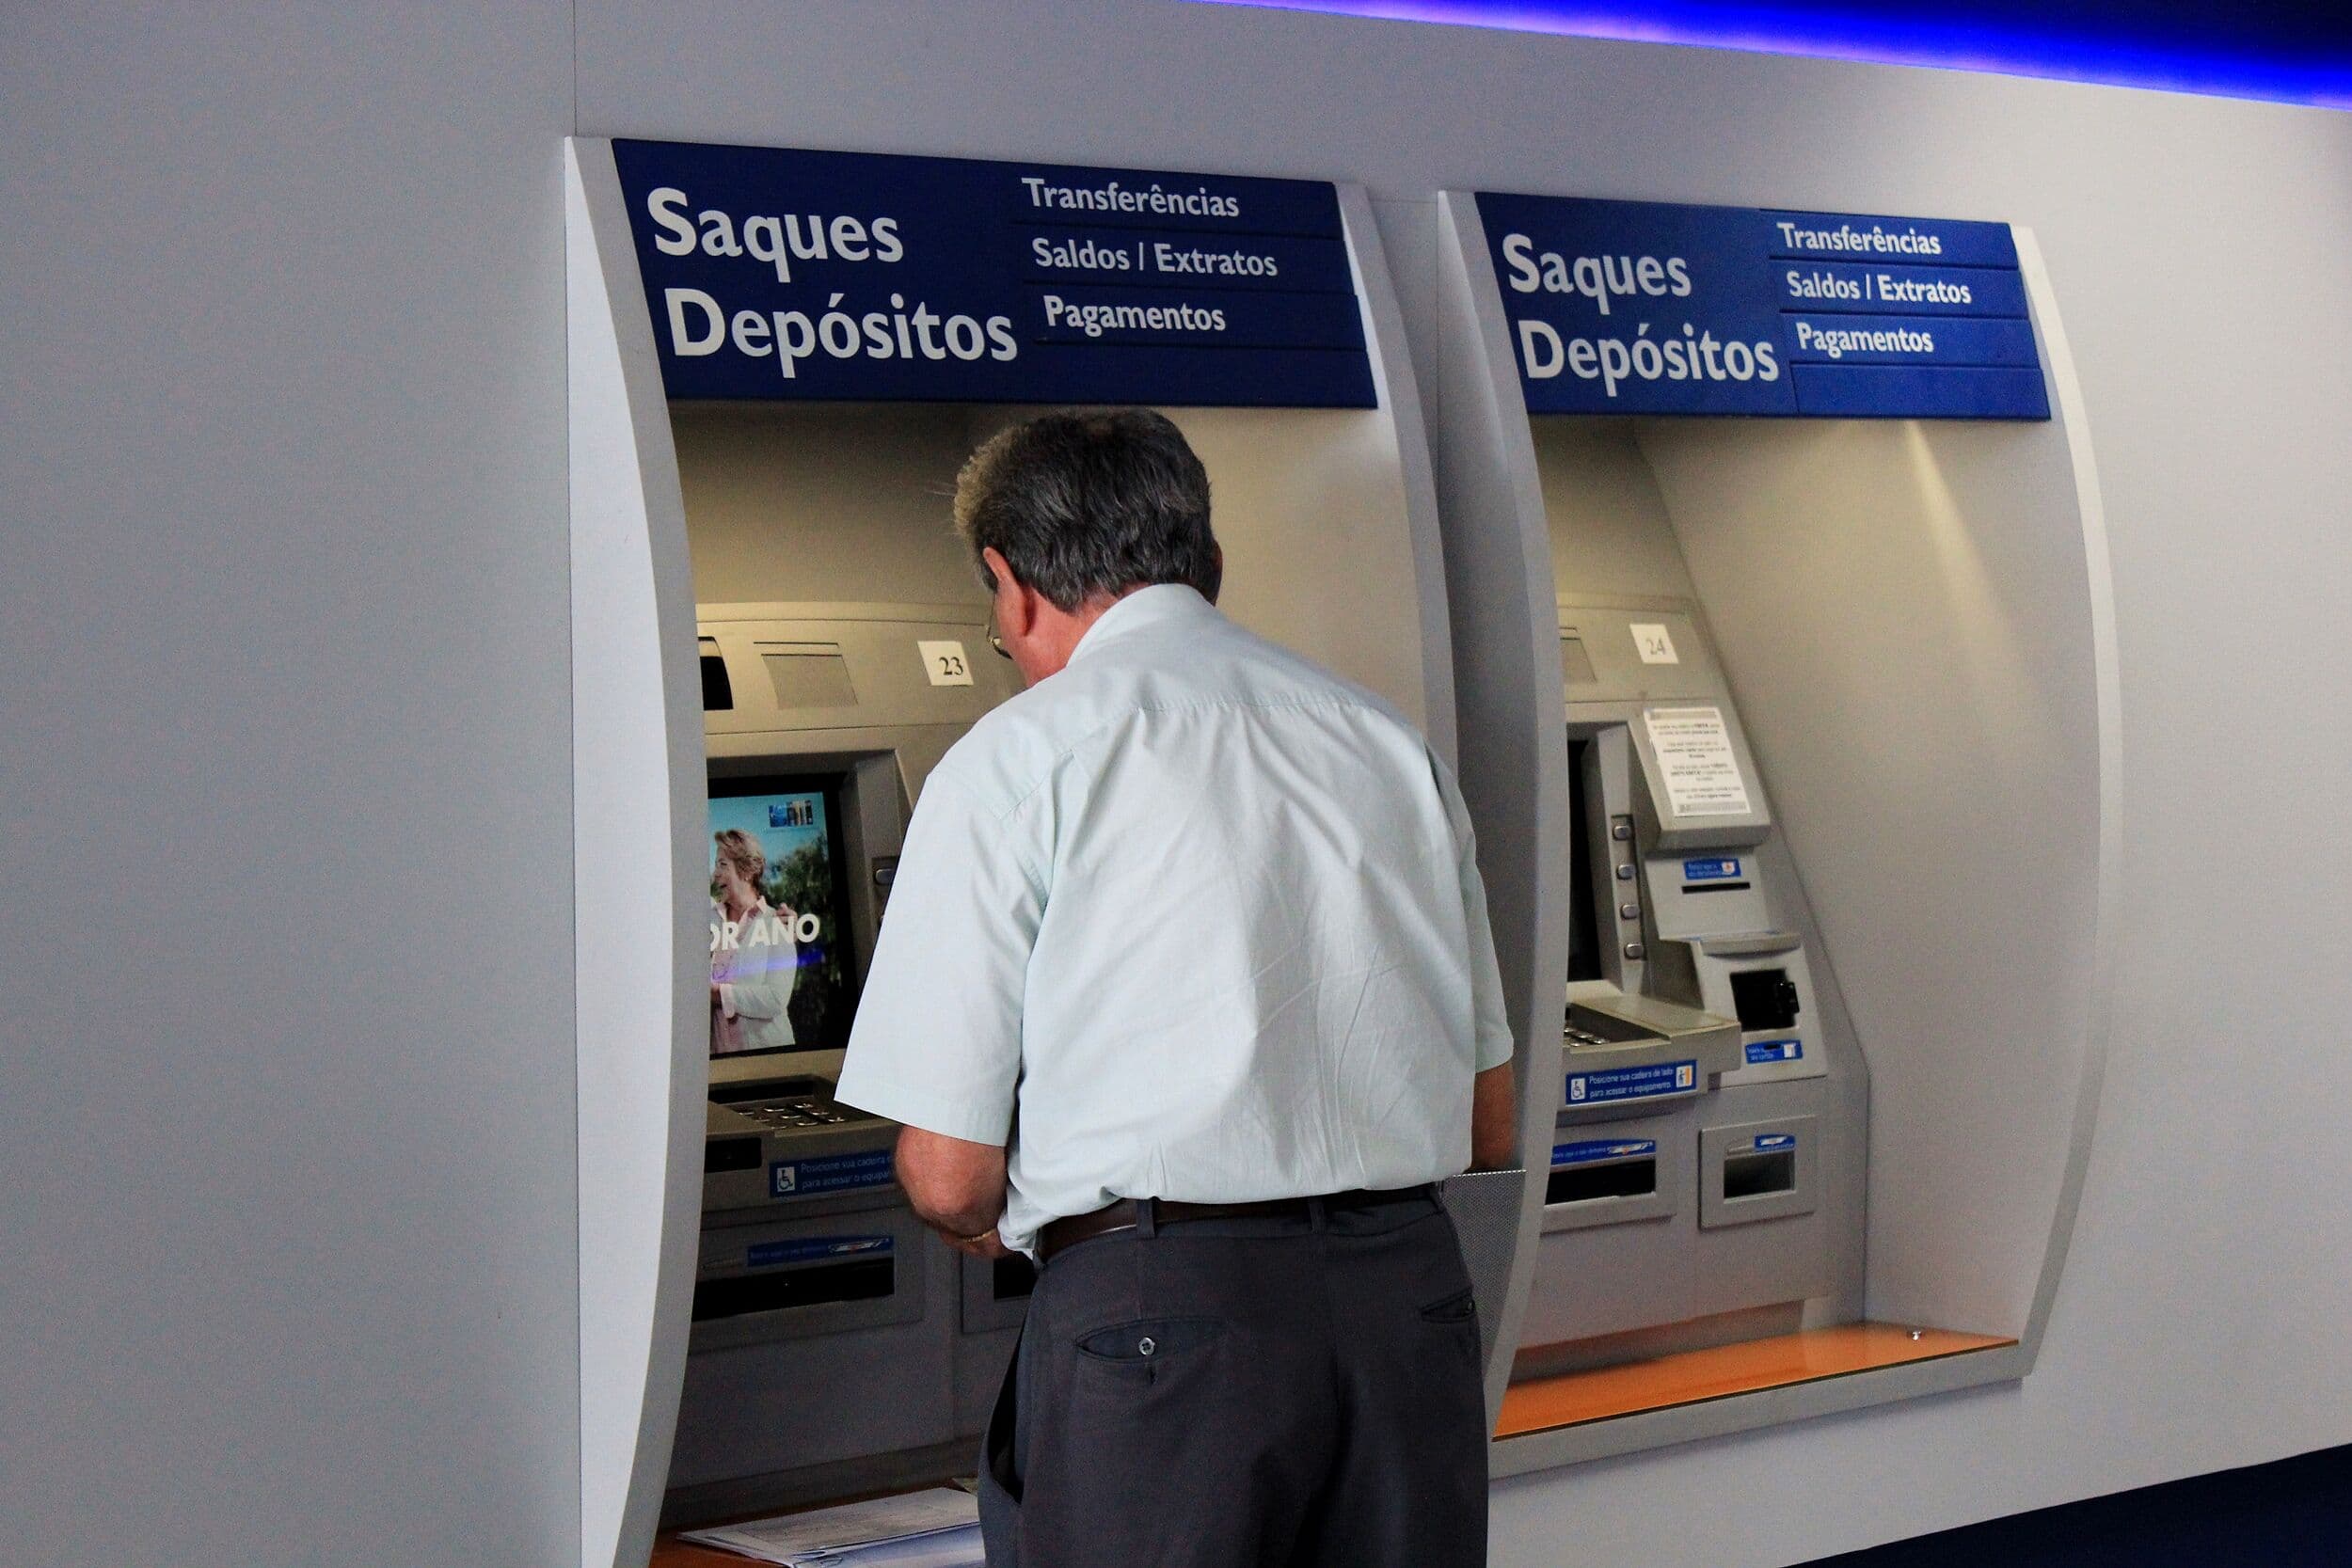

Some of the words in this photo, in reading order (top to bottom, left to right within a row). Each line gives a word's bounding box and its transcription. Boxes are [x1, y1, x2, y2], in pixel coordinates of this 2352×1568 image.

[1022, 177, 1240, 217] Transferências
[647, 187, 904, 283] Saques
[1777, 222, 1943, 255] Transferências
[1032, 237, 1130, 270] Saldos
[1137, 242, 1145, 271] /
[1155, 243, 1278, 277] Extratos
[1502, 233, 1692, 315] Saques
[1787, 270, 1861, 300] Saldos
[1866, 274, 1872, 300] /
[1877, 274, 1972, 305] Extratos
[664, 288, 1019, 379] Depósitos
[1043, 294, 1227, 338] Pagamentos
[1797, 322, 1934, 359] Pagamentos
[1518, 321, 1780, 397] Depósitos
[1645, 638, 1666, 656] 24
[939, 657, 964, 676] 23
[749, 913, 820, 947] ANO
[1589, 1075, 1619, 1084] Posicione
[1630, 1070, 1652, 1081] cadeira
[1652, 1069, 1661, 1078] de
[1589, 1089, 1604, 1099] para
[801, 1162, 840, 1174] Posicione
[802, 1179, 820, 1191] para
